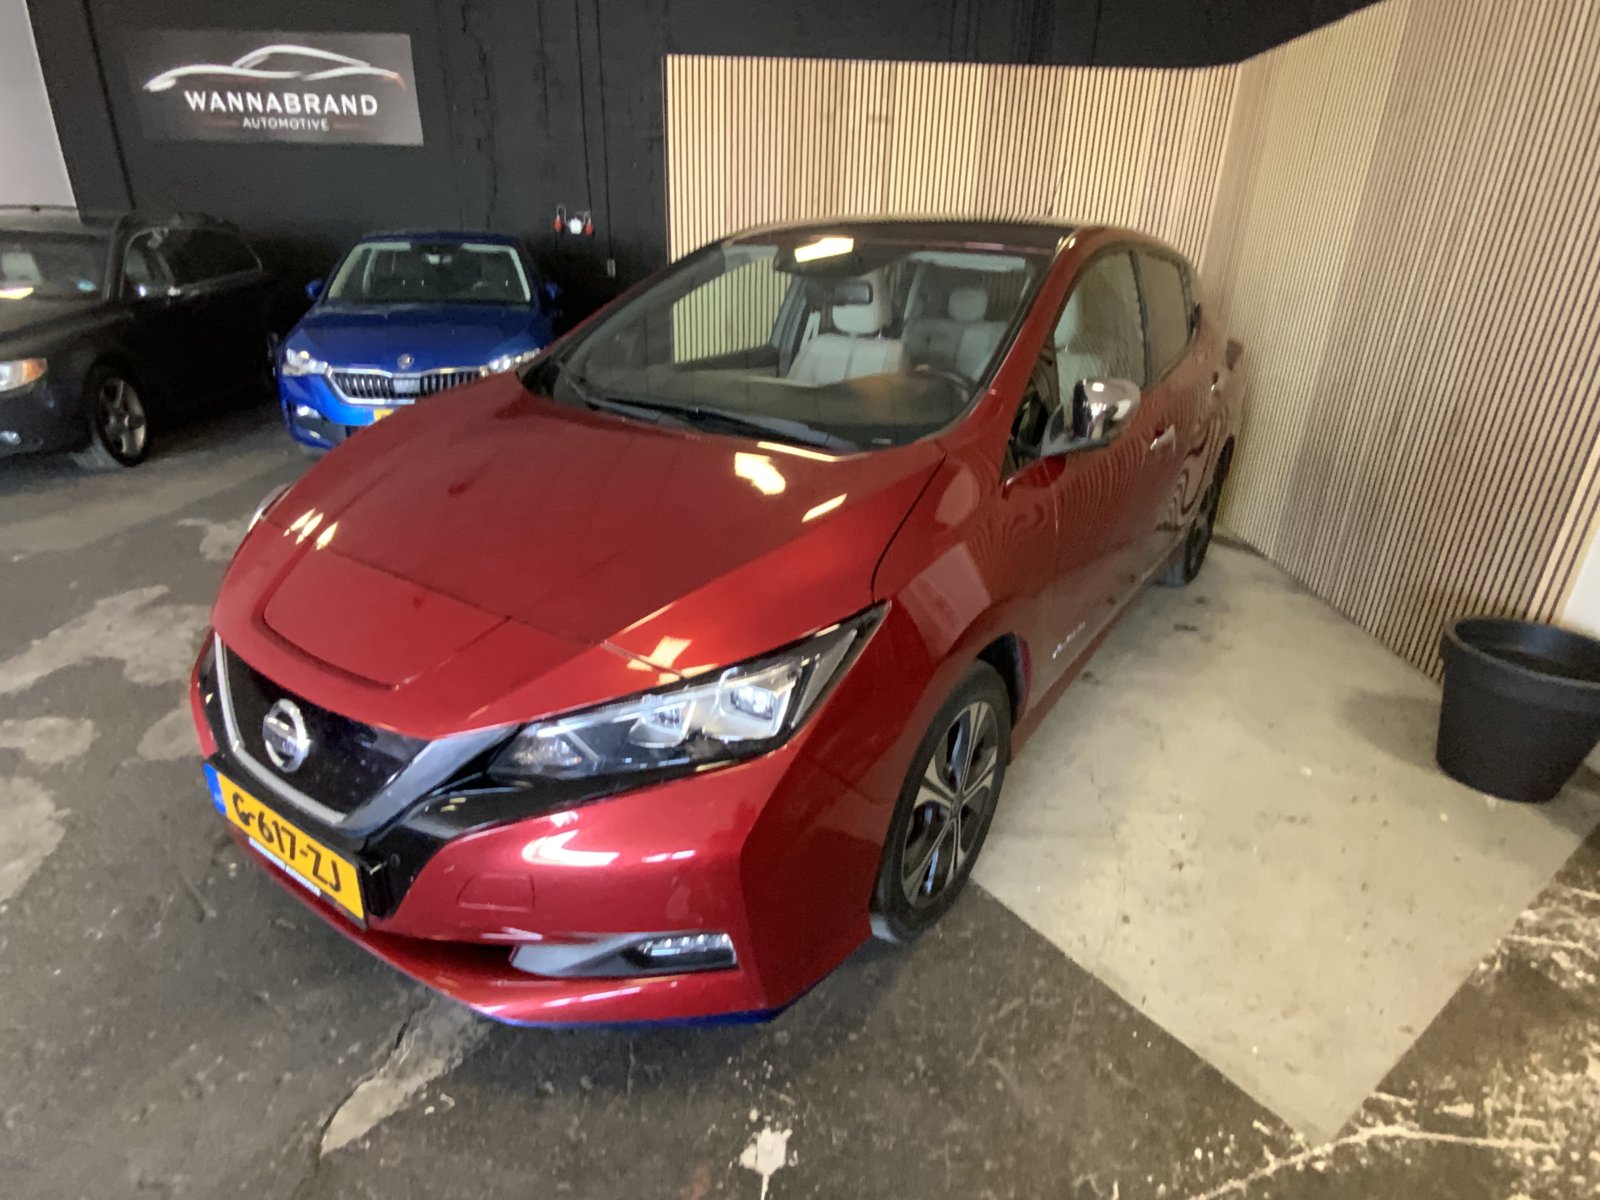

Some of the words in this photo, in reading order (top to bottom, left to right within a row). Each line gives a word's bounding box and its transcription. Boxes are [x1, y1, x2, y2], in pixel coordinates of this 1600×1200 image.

[184, 90, 378, 116] WANNABRAND
[242, 116, 330, 131] AUTOMOTIVE
[232, 792, 342, 893] G-617-ZJ
